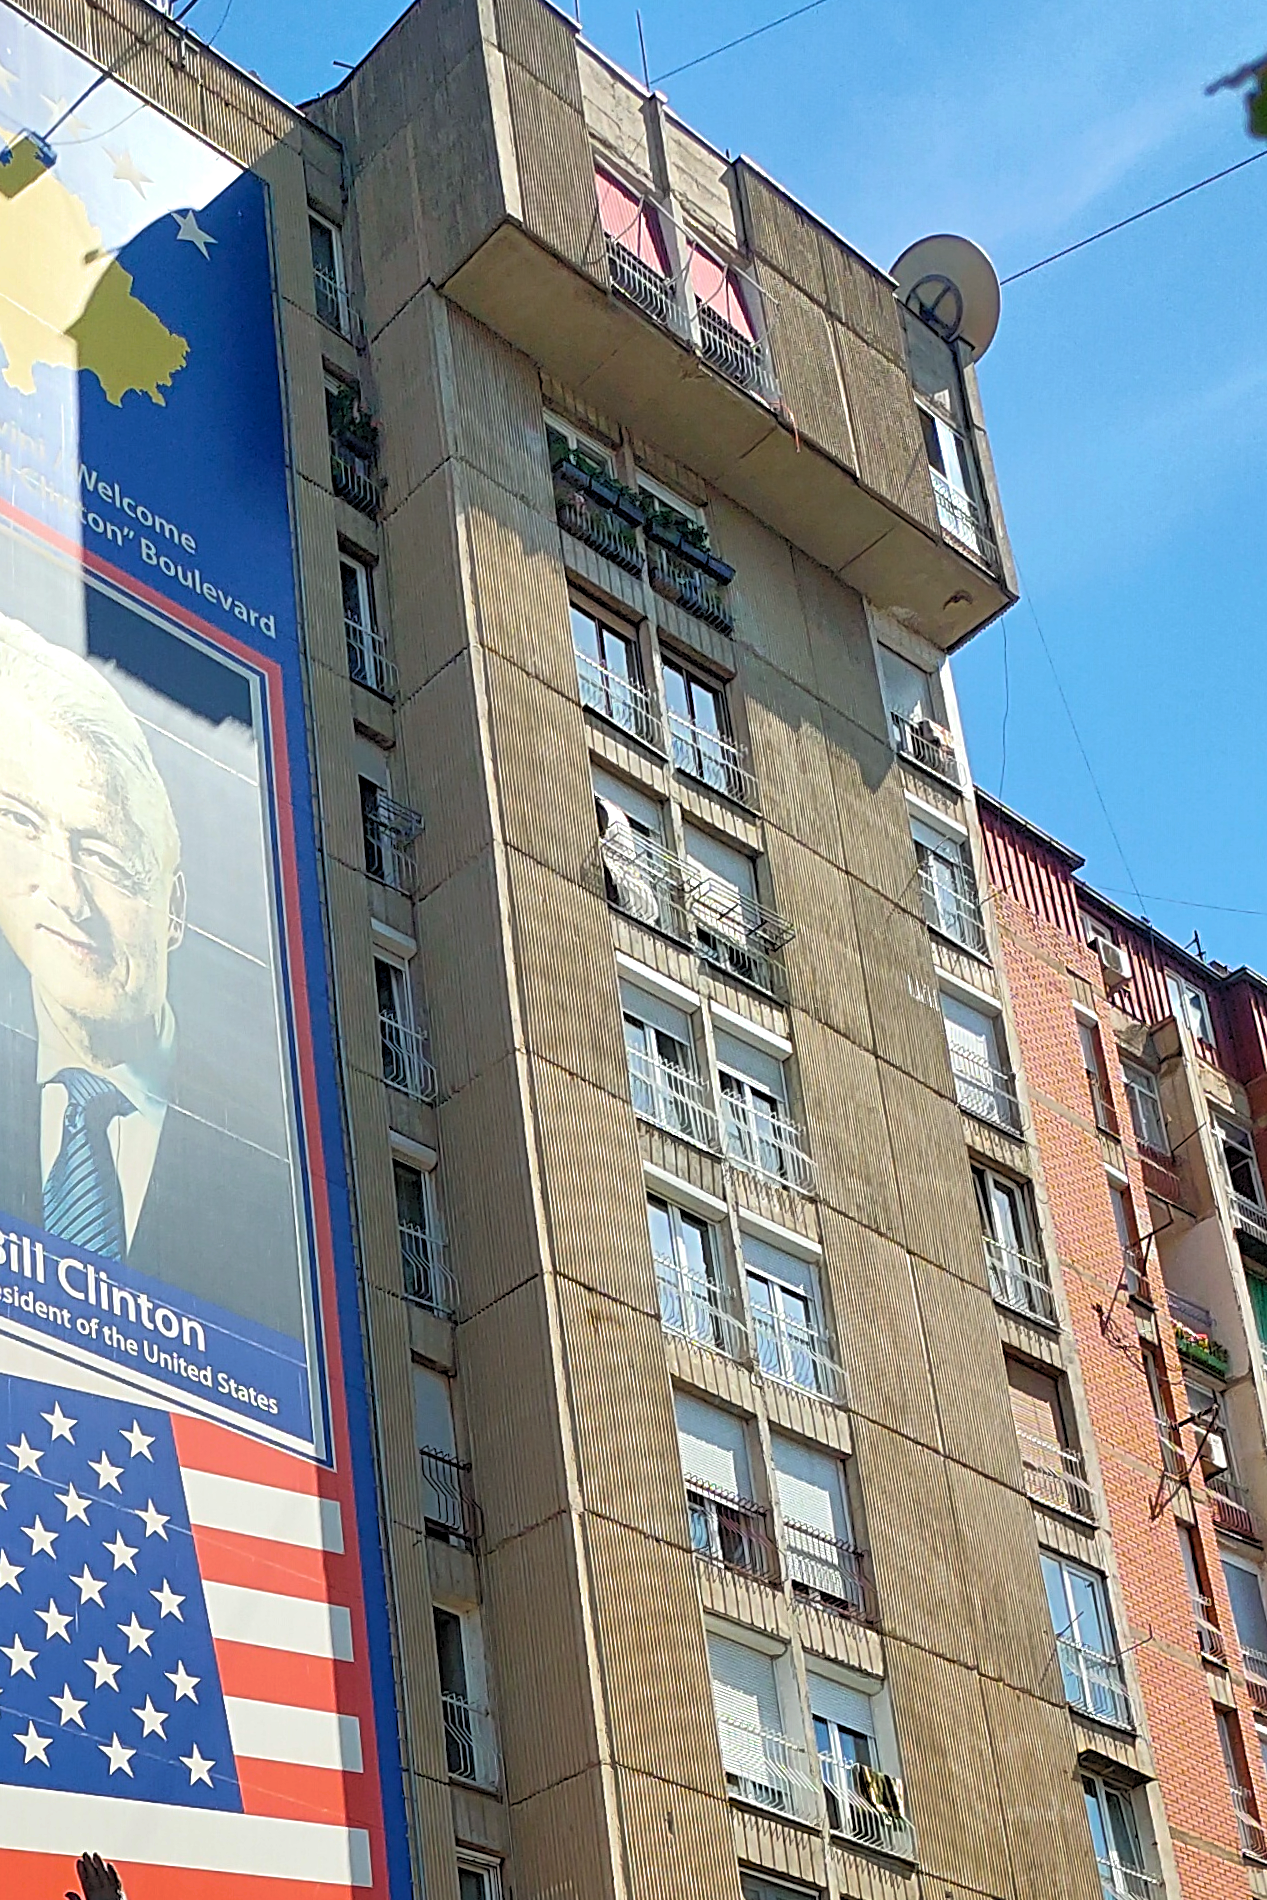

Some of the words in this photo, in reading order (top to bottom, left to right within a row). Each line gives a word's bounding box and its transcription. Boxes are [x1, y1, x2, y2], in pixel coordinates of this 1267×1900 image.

[70, 456, 196, 554] Welcome
[140, 537, 276, 639] Boulevard
[58, 1257, 206, 1352] Clinton
[76, 1317, 100, 1340] of
[102, 1326, 139, 1356] the
[143, 1340, 213, 1389] United
[217, 1371, 279, 1415] States
